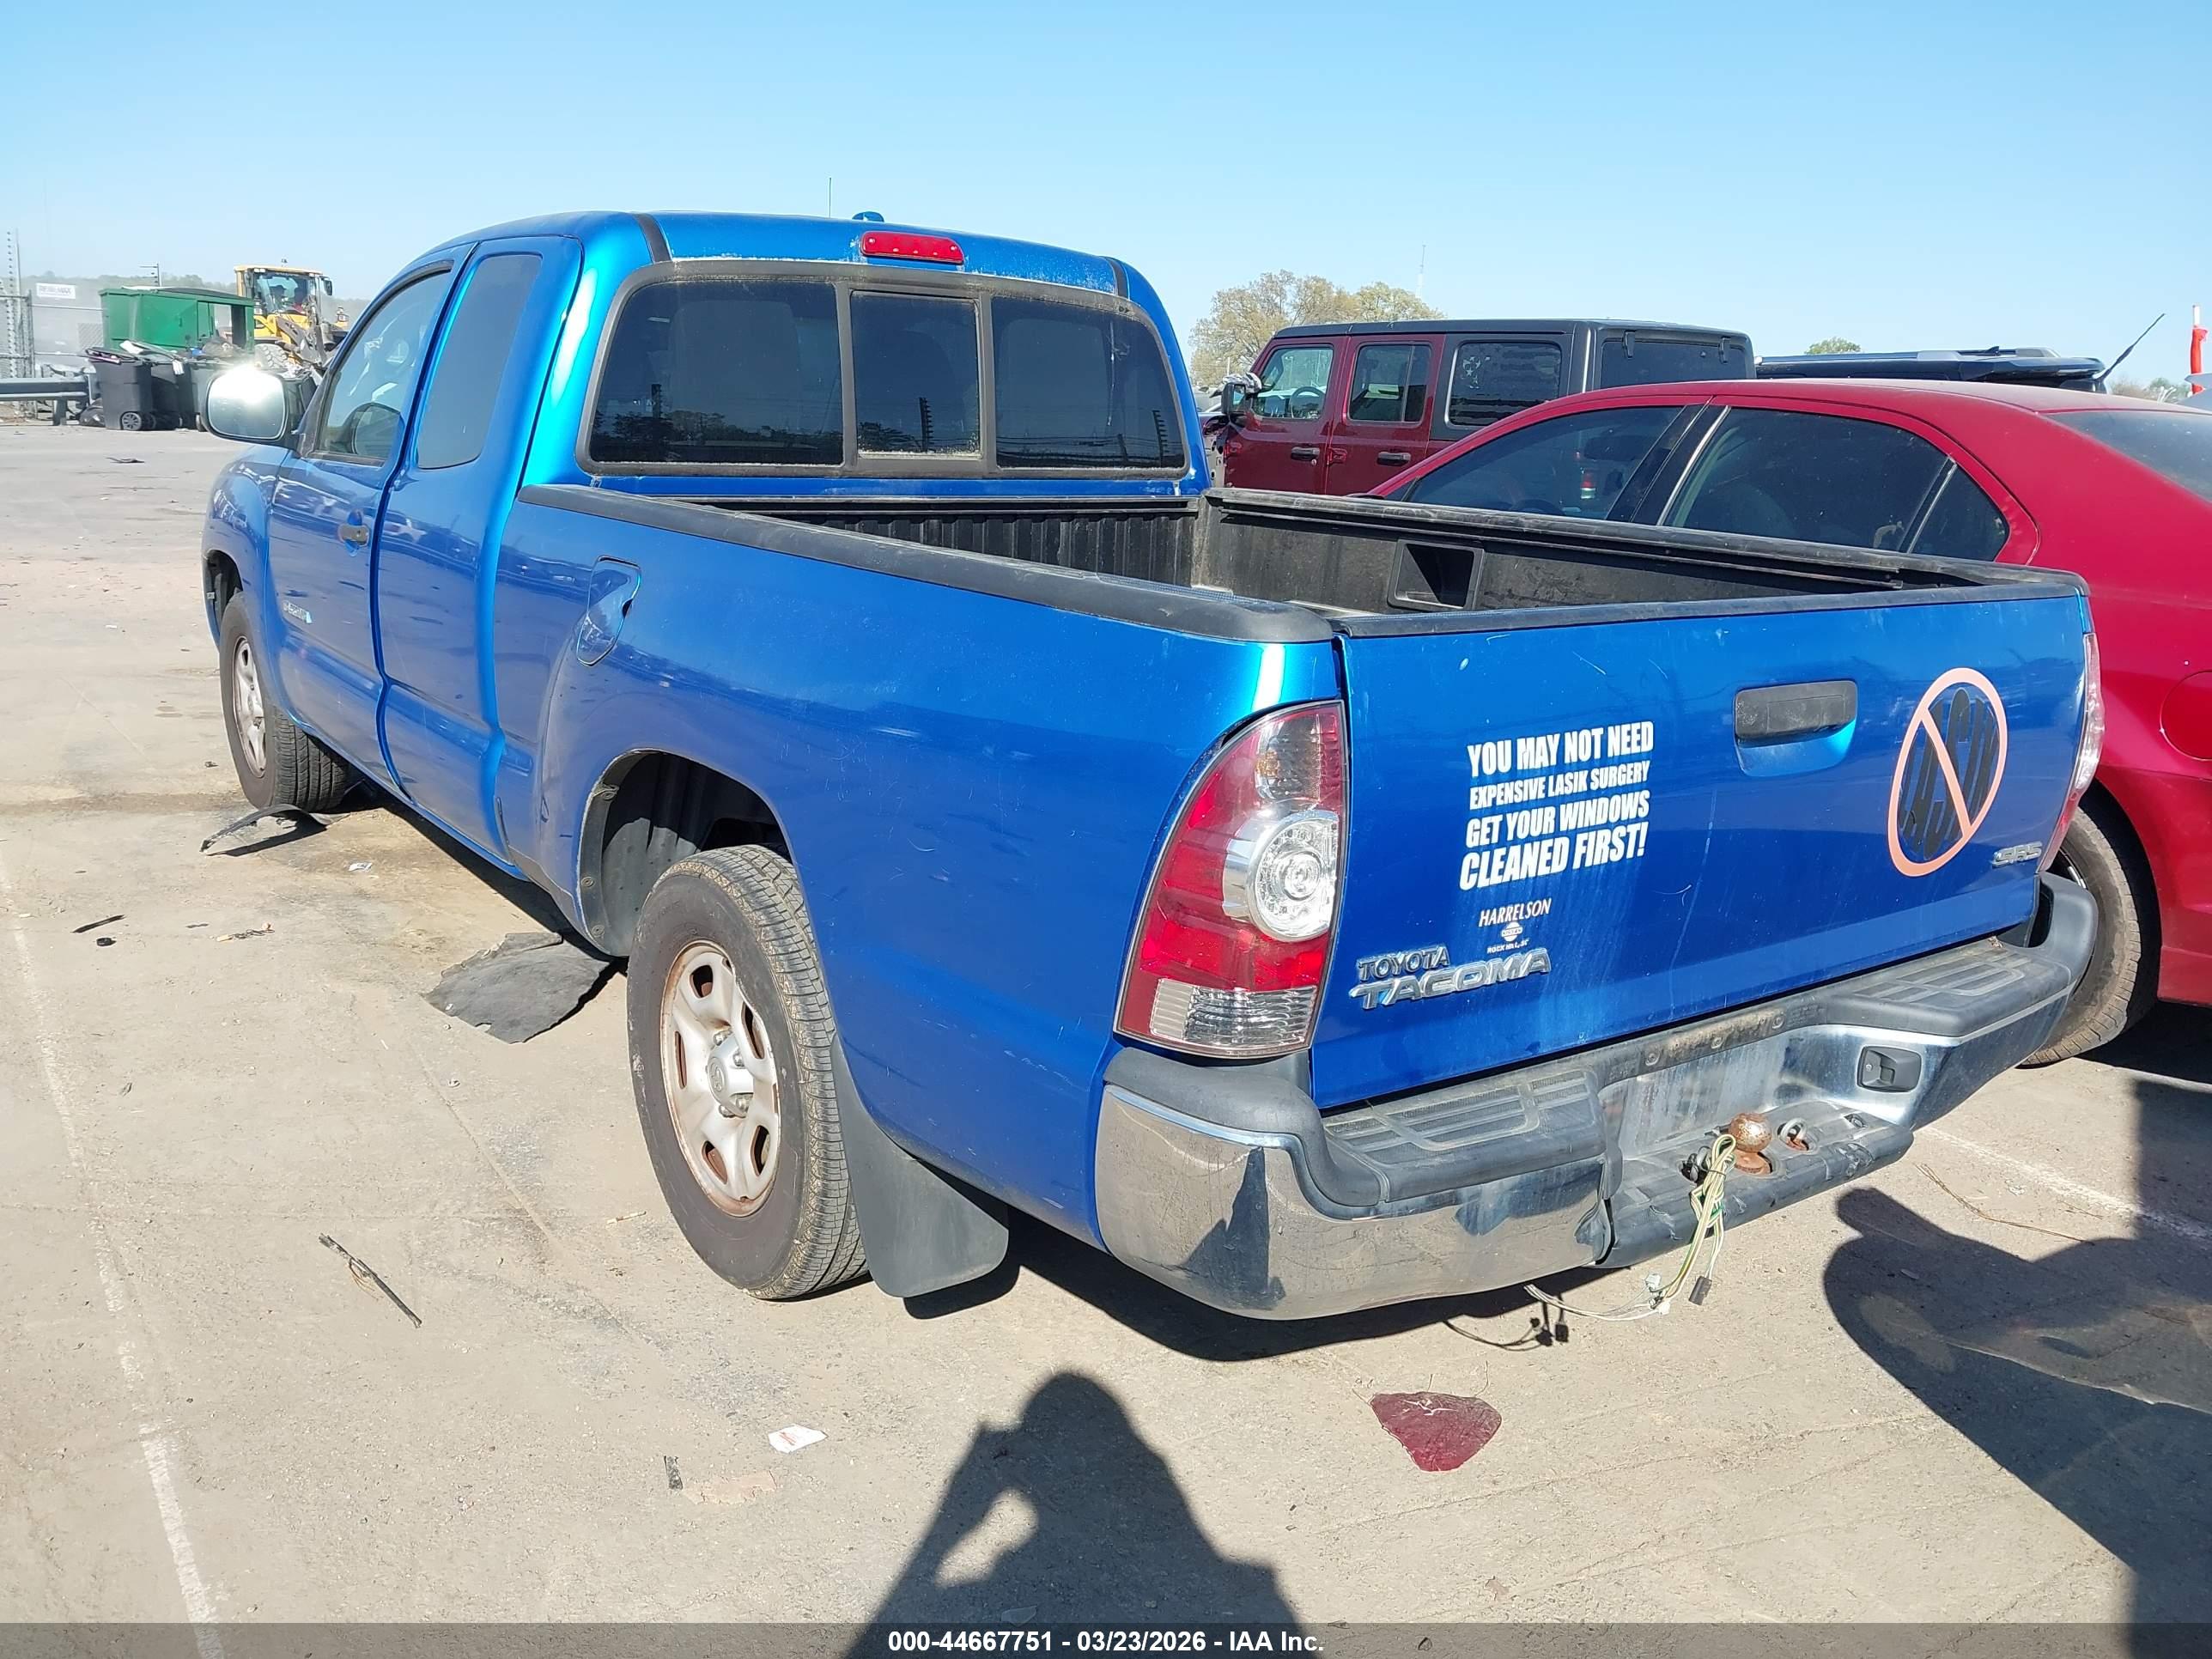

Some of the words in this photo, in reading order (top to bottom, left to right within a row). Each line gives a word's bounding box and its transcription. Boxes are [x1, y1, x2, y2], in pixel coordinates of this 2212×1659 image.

[1467, 739, 1512, 777] YOU
[1516, 733, 1561, 770] MAY
[1564, 727, 1604, 763] NOT
[1607, 720, 1654, 757] NEED
[1469, 776, 1546, 811] EXPENSIVE
[1547, 769, 1589, 798] LASIK
[1589, 760, 1650, 791] SURGERY
[1466, 814, 1504, 848] GET
[1506, 806, 1556, 842] YOUR
[1559, 789, 1650, 832] WINDOWS
[1459, 836, 1570, 890] CLEANED
[1572, 821, 1649, 870] FIRST!
[1478, 897, 1552, 927] HARRELSON
[1358, 945, 1449, 981] TOYOTA
[1486, 945, 1506, 954] ROCK
[1349, 948, 1551, 1009] TACOMA
